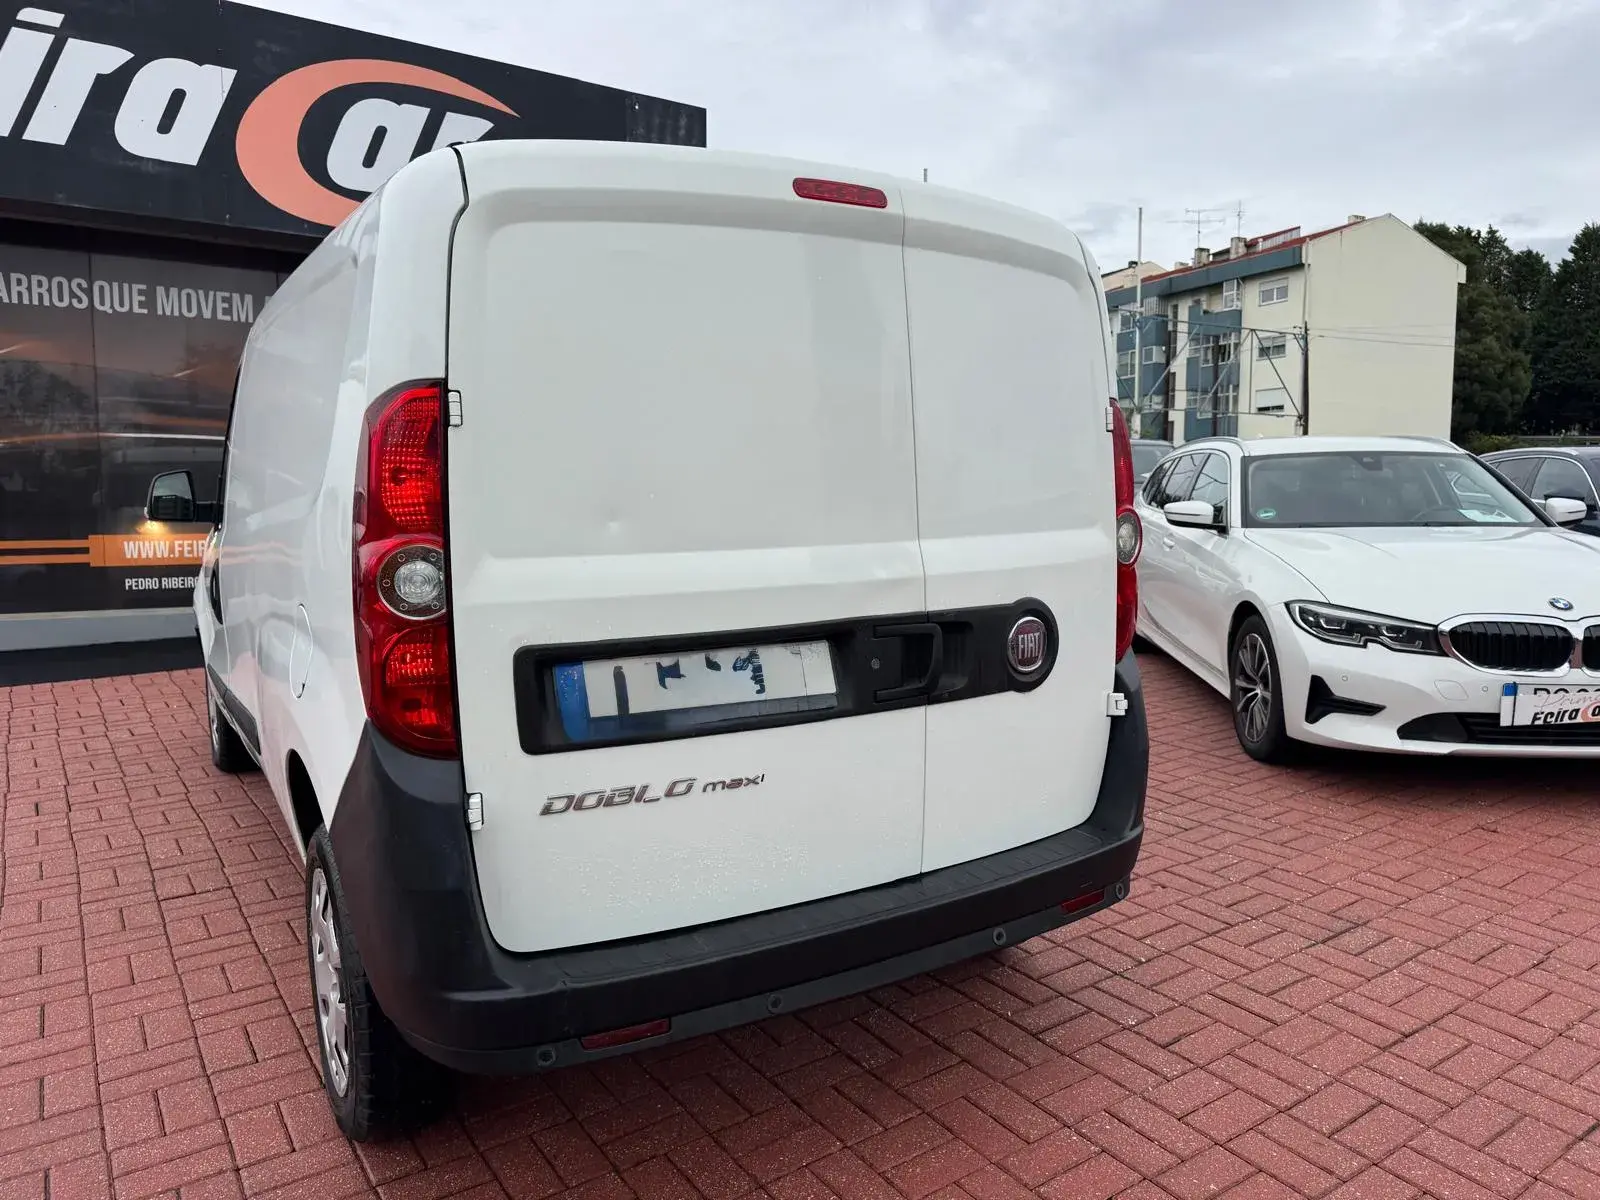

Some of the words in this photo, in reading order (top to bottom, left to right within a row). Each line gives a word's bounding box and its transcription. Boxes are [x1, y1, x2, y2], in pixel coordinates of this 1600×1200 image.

[93, 280, 148, 314] QUE
[156, 286, 254, 323] MOVEM
[125, 577, 159, 591] PEDRO
[1018, 631, 1040, 660] FIAT
[1531, 707, 1581, 725] Feira
